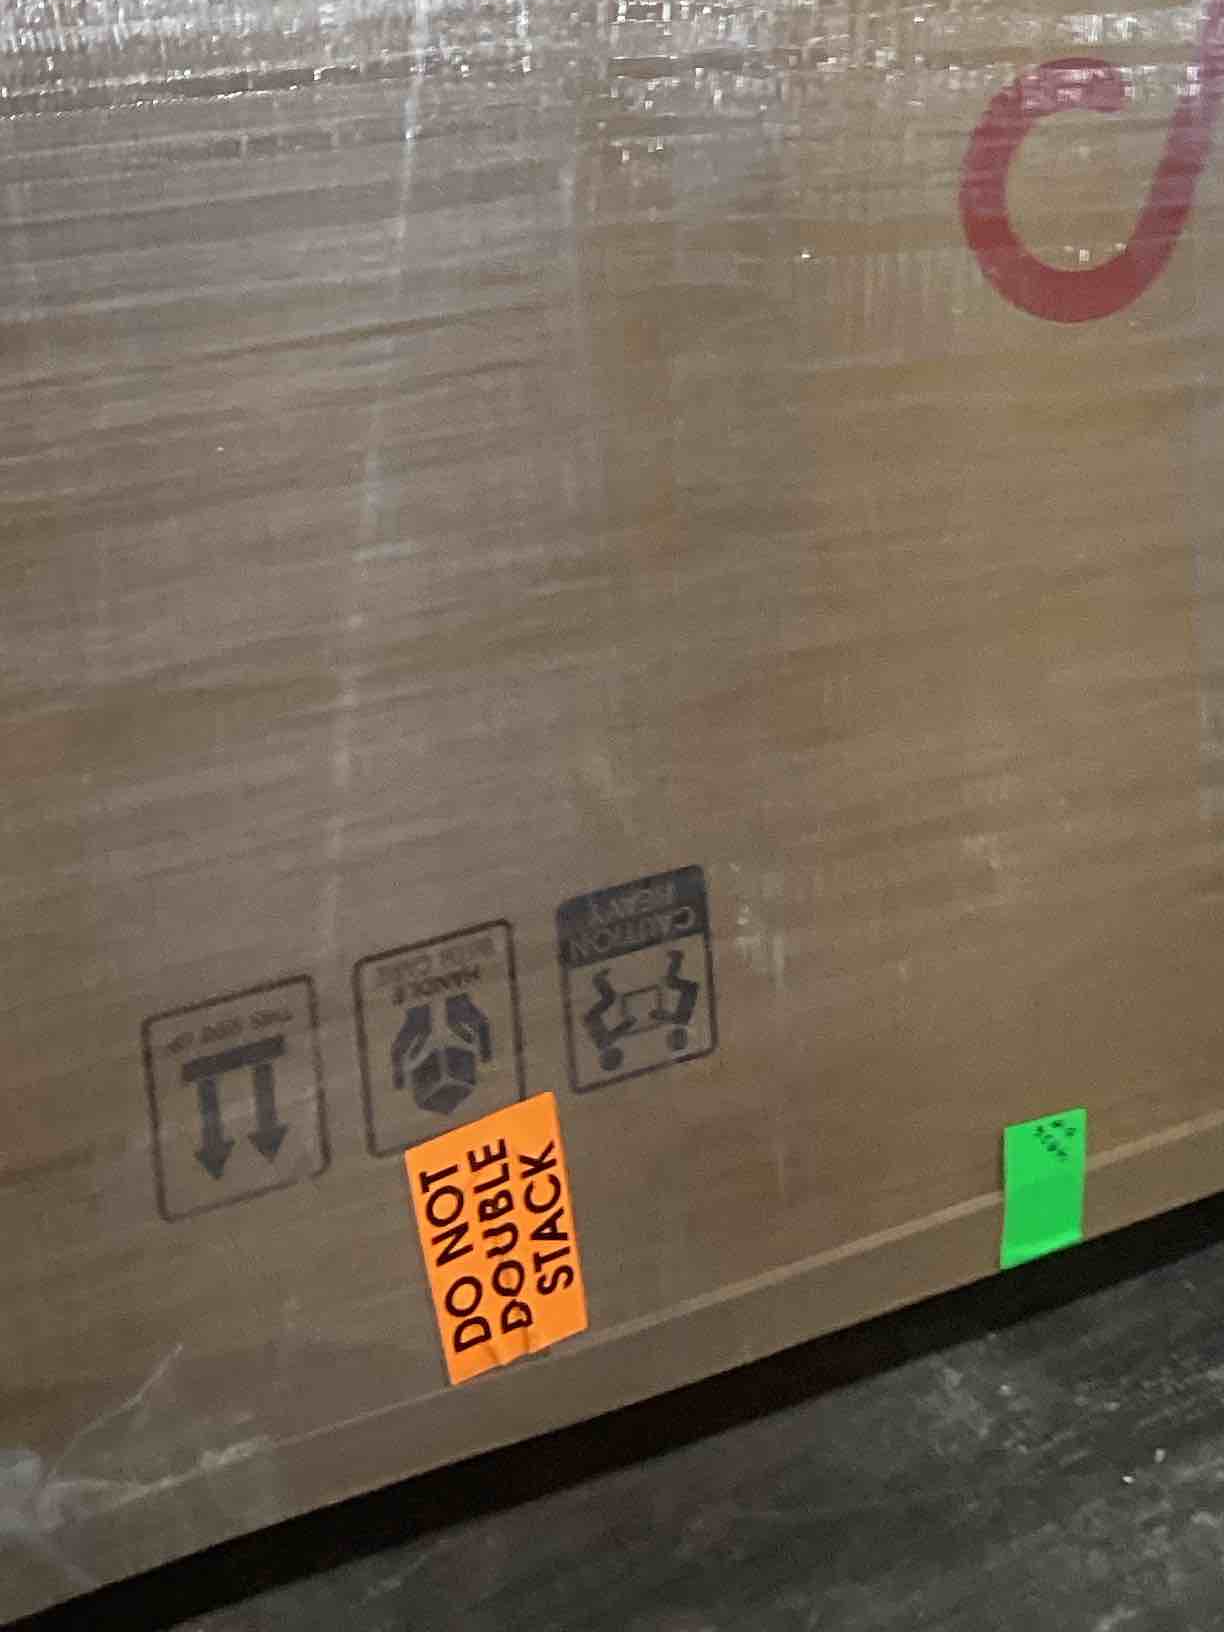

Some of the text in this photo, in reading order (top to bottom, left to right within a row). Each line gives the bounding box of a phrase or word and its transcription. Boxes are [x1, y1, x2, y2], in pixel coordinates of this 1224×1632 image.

[564, 905, 698, 966] CAUTION
[419, 1164, 493, 1353] DO NOT
[466, 1136, 535, 1335] DOUBLE
[518, 1139, 575, 1296] STACK
